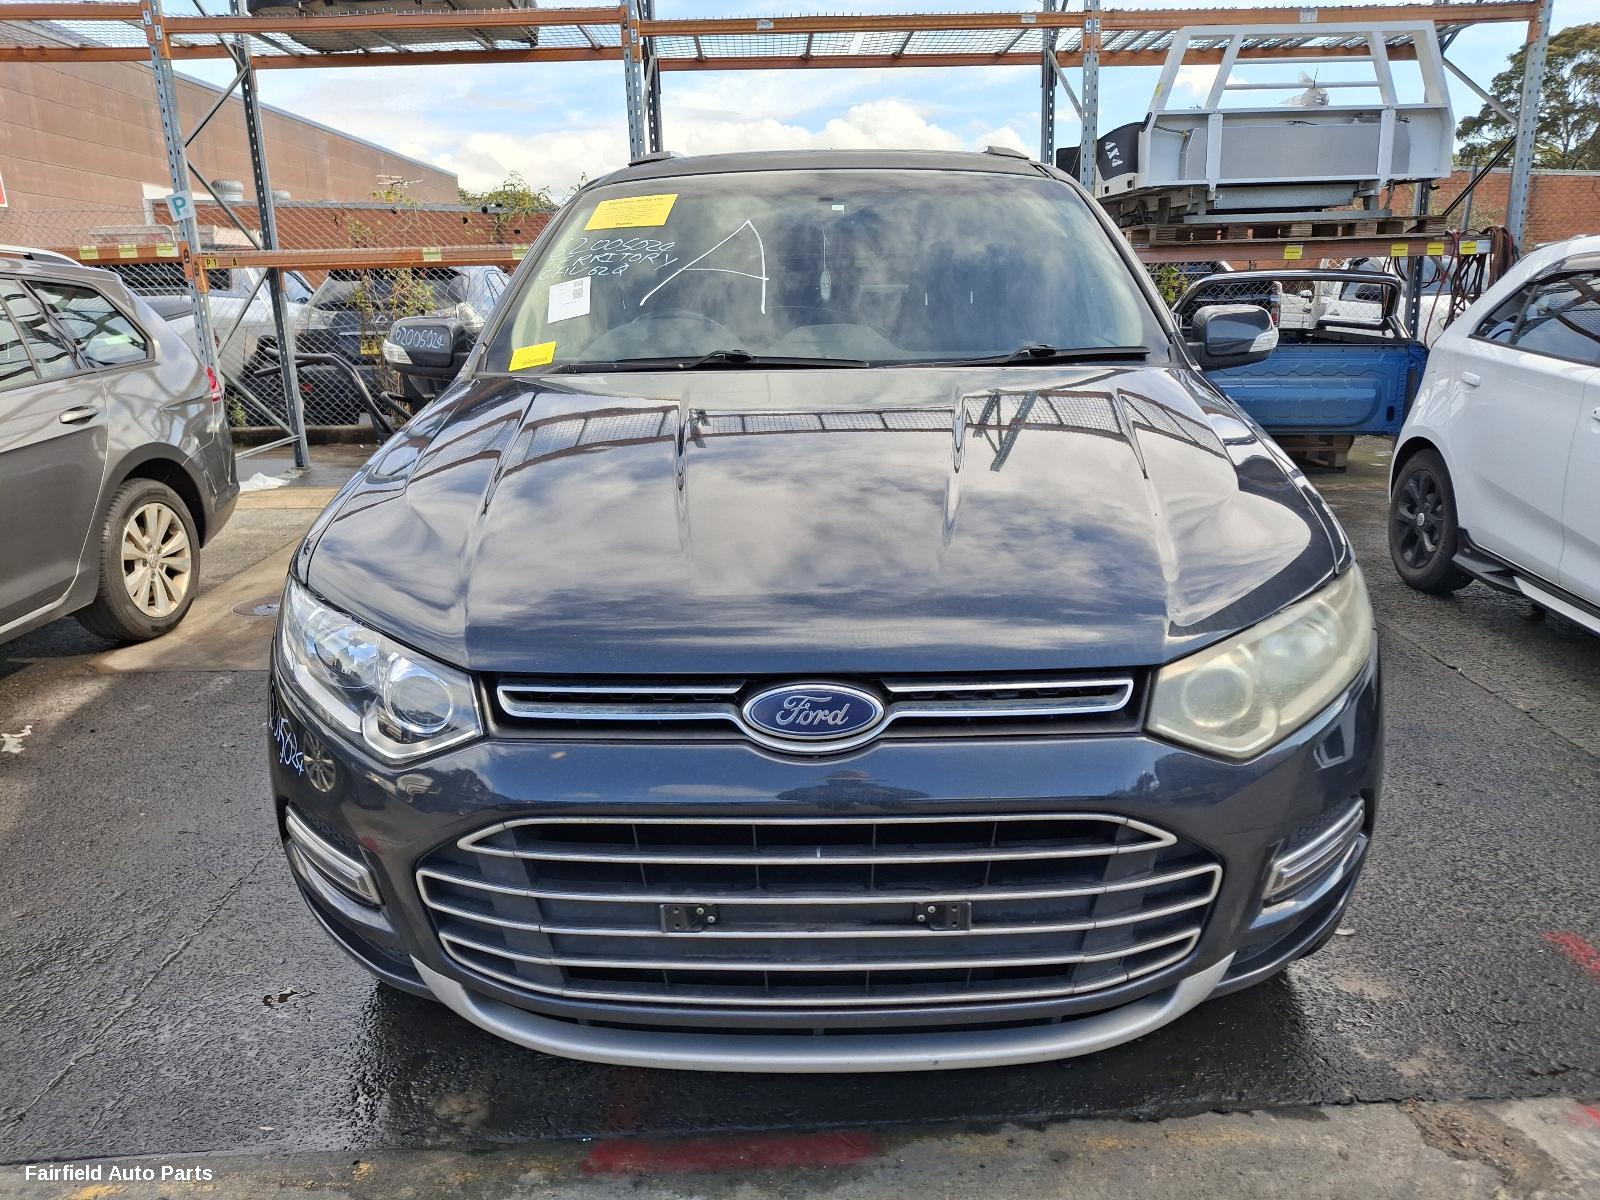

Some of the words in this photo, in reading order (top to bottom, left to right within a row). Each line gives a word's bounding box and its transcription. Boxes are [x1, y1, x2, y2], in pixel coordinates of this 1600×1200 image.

[172, 196, 186, 216] P
[640, 219, 769, 314] A
[395, 325, 445, 349] 62005024
[776, 695, 850, 725] Ford
